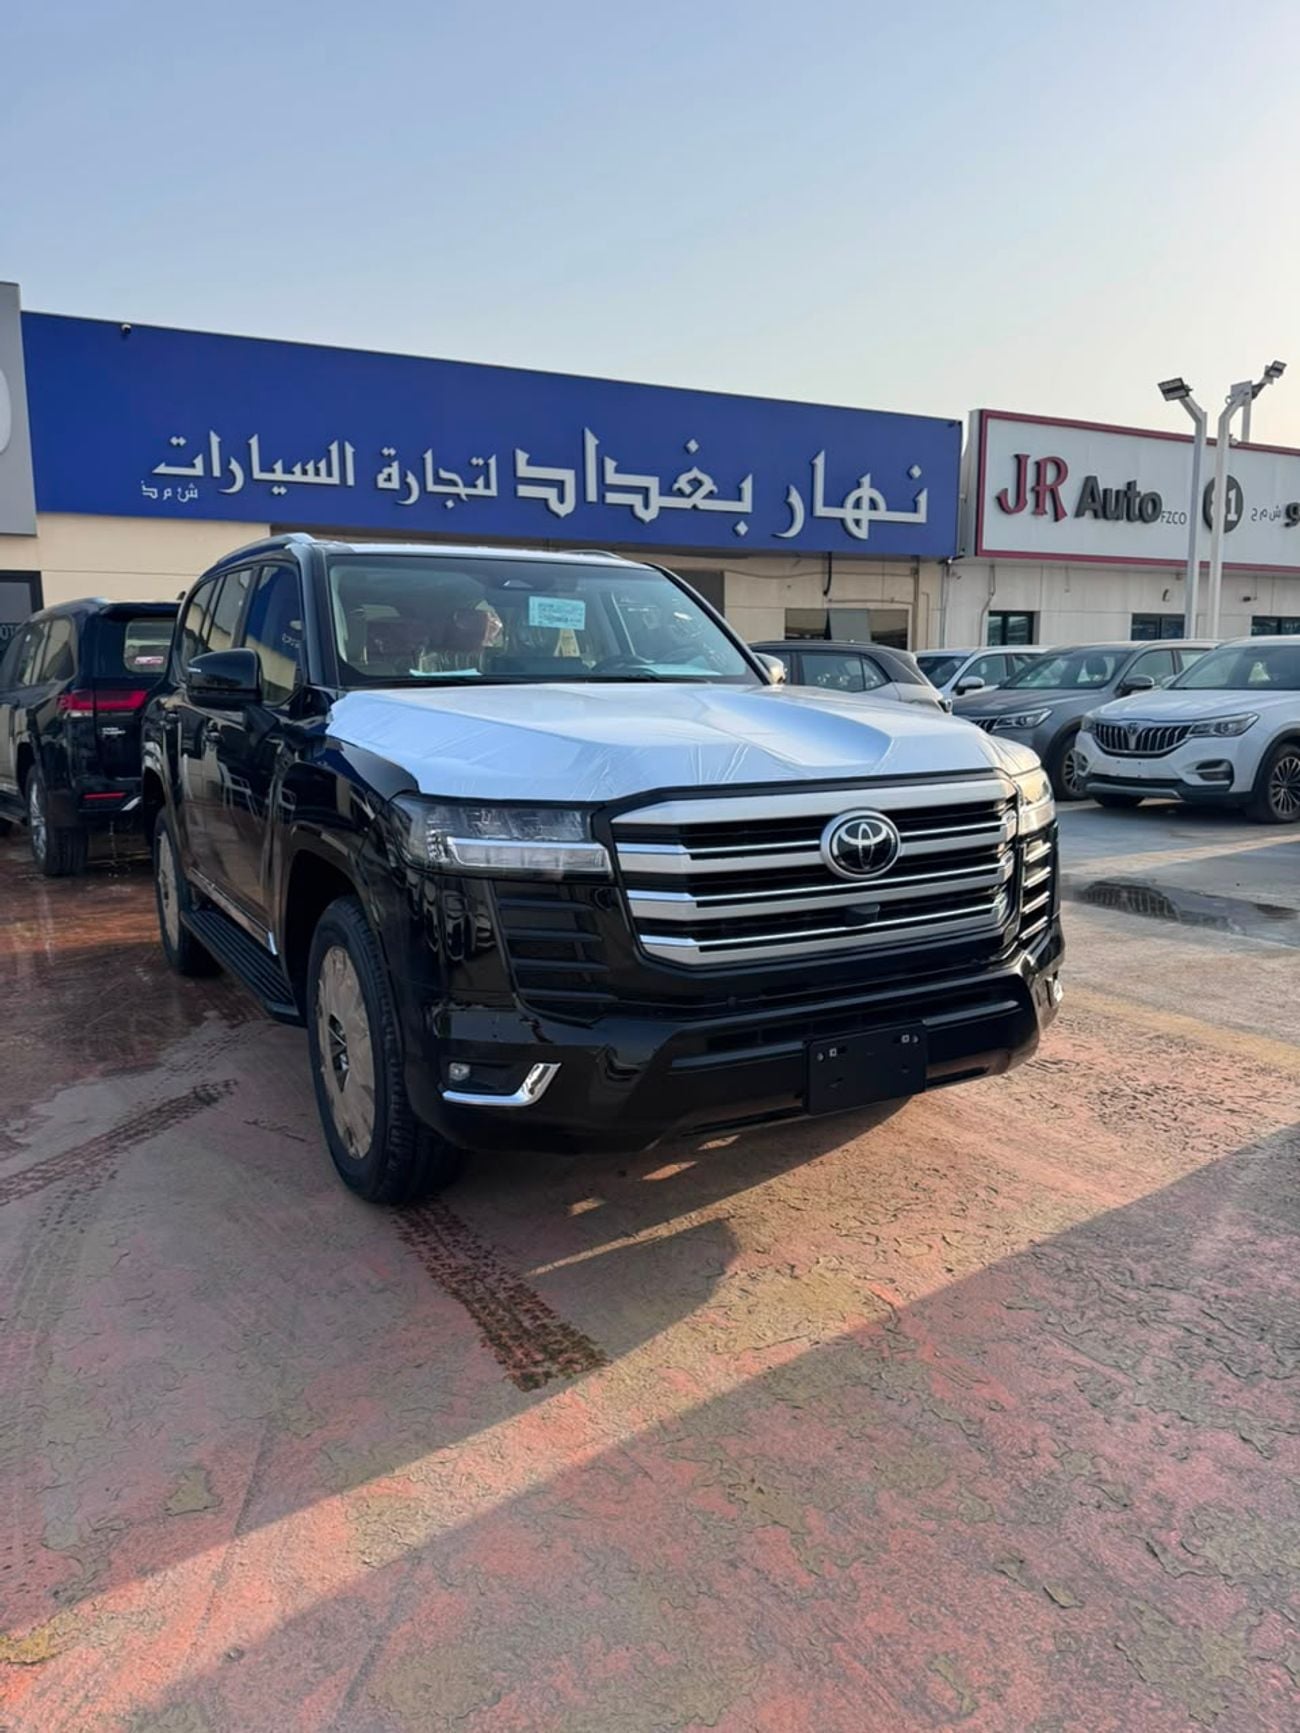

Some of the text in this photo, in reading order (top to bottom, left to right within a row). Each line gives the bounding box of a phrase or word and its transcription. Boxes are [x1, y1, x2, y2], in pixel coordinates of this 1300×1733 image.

[151, 427, 928, 540] نهار بغداد لتجارة السيارات
[994, 453, 1188, 526] JR Auto FZCO
